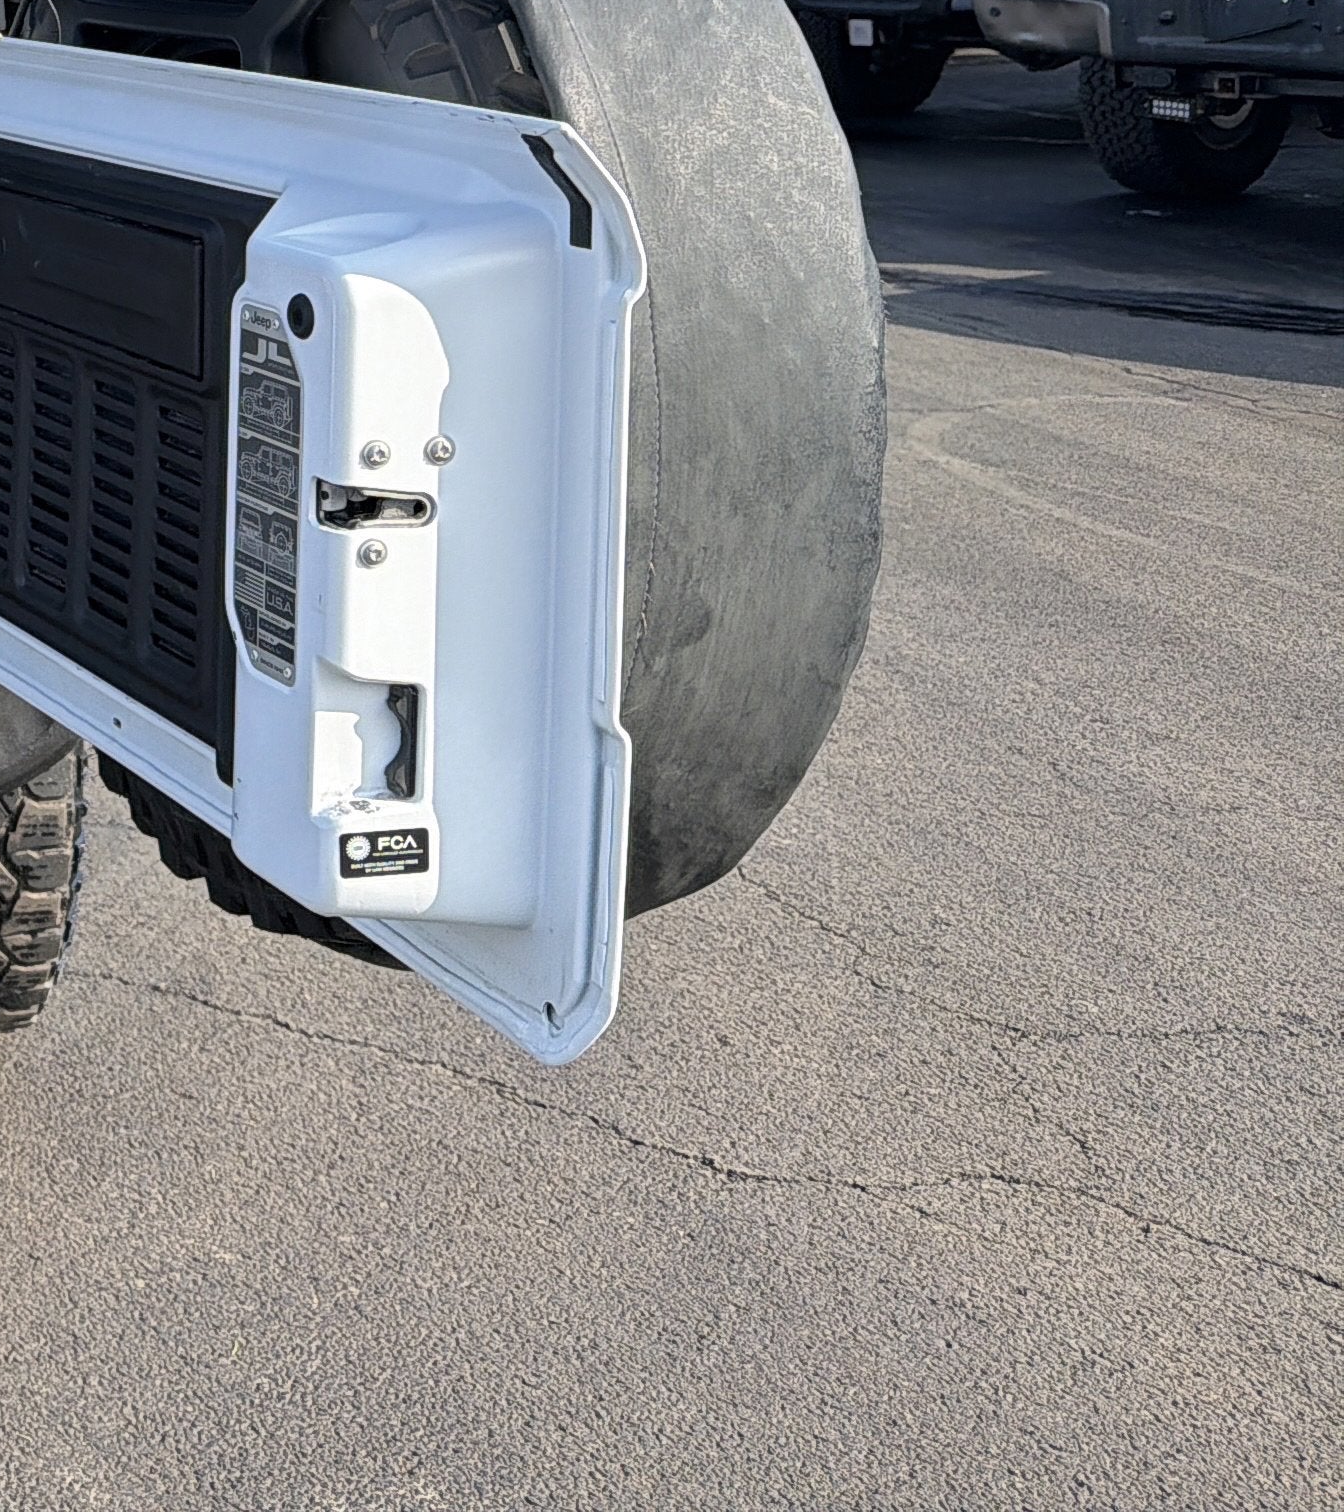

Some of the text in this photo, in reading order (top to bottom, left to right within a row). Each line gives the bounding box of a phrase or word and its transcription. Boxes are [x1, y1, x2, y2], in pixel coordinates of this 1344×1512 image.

[250, 310, 272, 332] Jeep
[242, 337, 293, 368] JL
[377, 834, 418, 852] FCA
